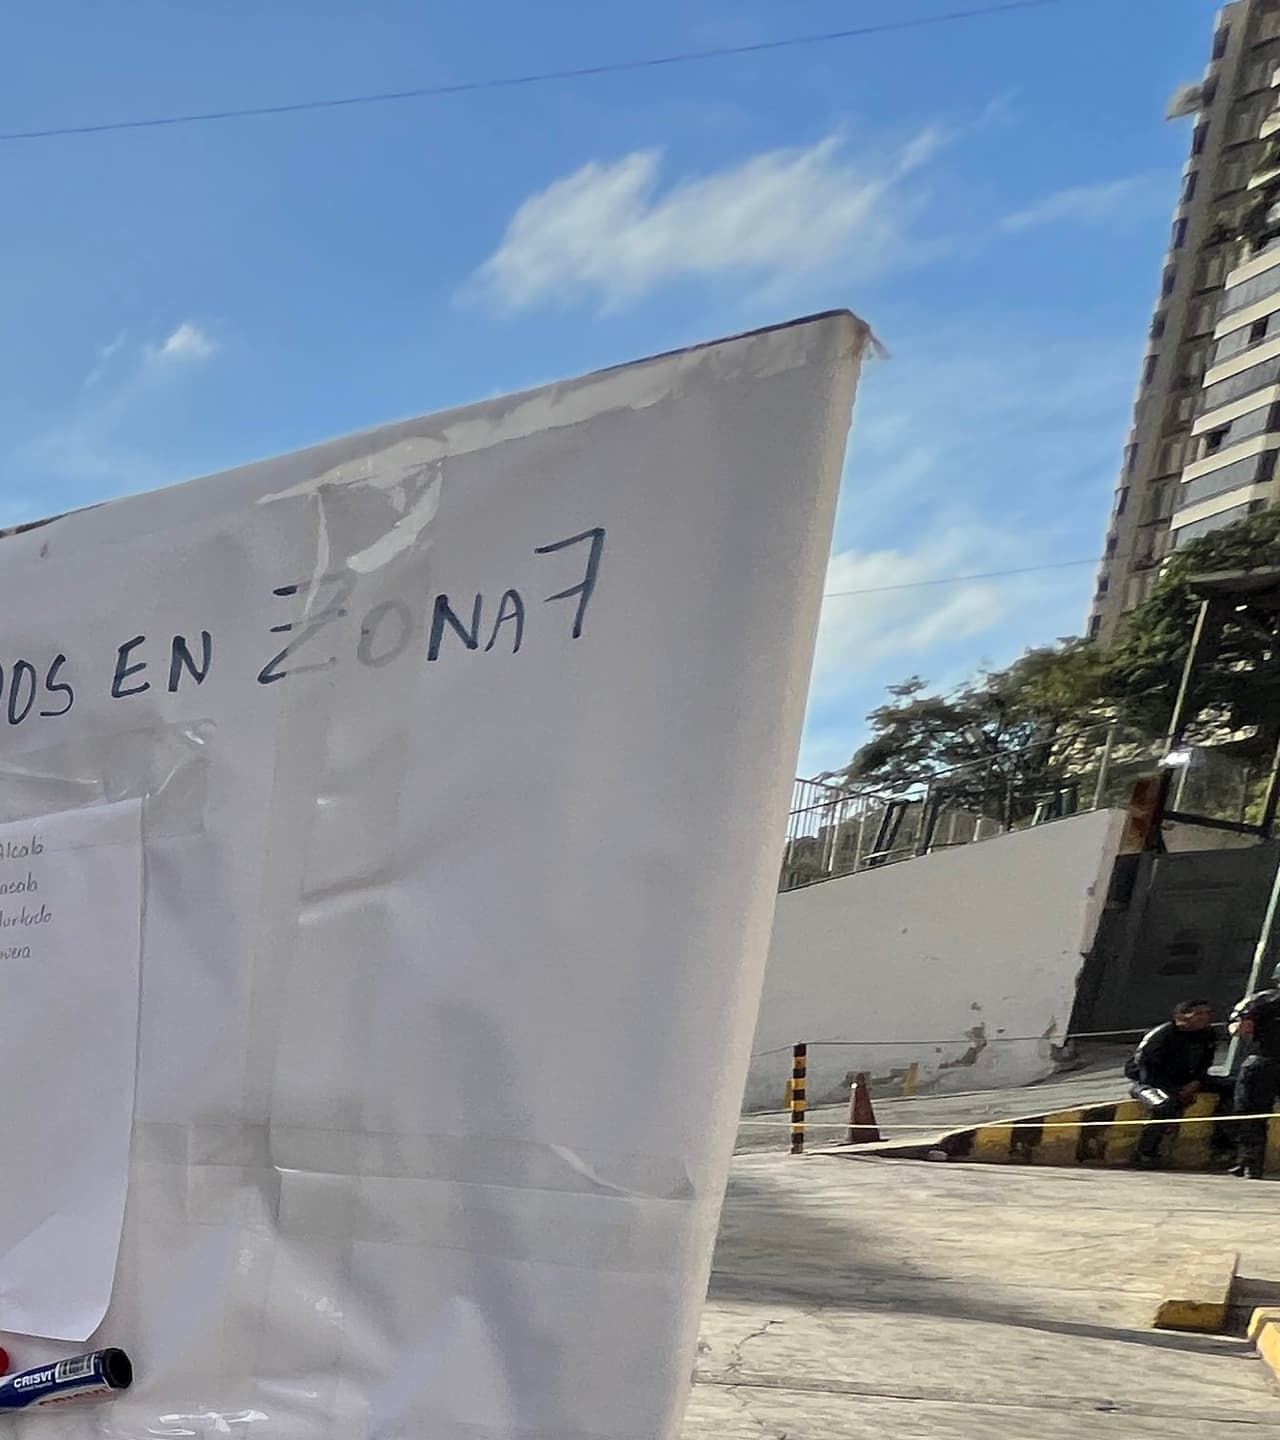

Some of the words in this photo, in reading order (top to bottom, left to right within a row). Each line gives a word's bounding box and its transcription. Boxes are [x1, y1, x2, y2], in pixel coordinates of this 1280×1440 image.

[111, 630, 211, 698] EN
[257, 572, 525, 685] ZONA
[535, 527, 605, 639] 7
